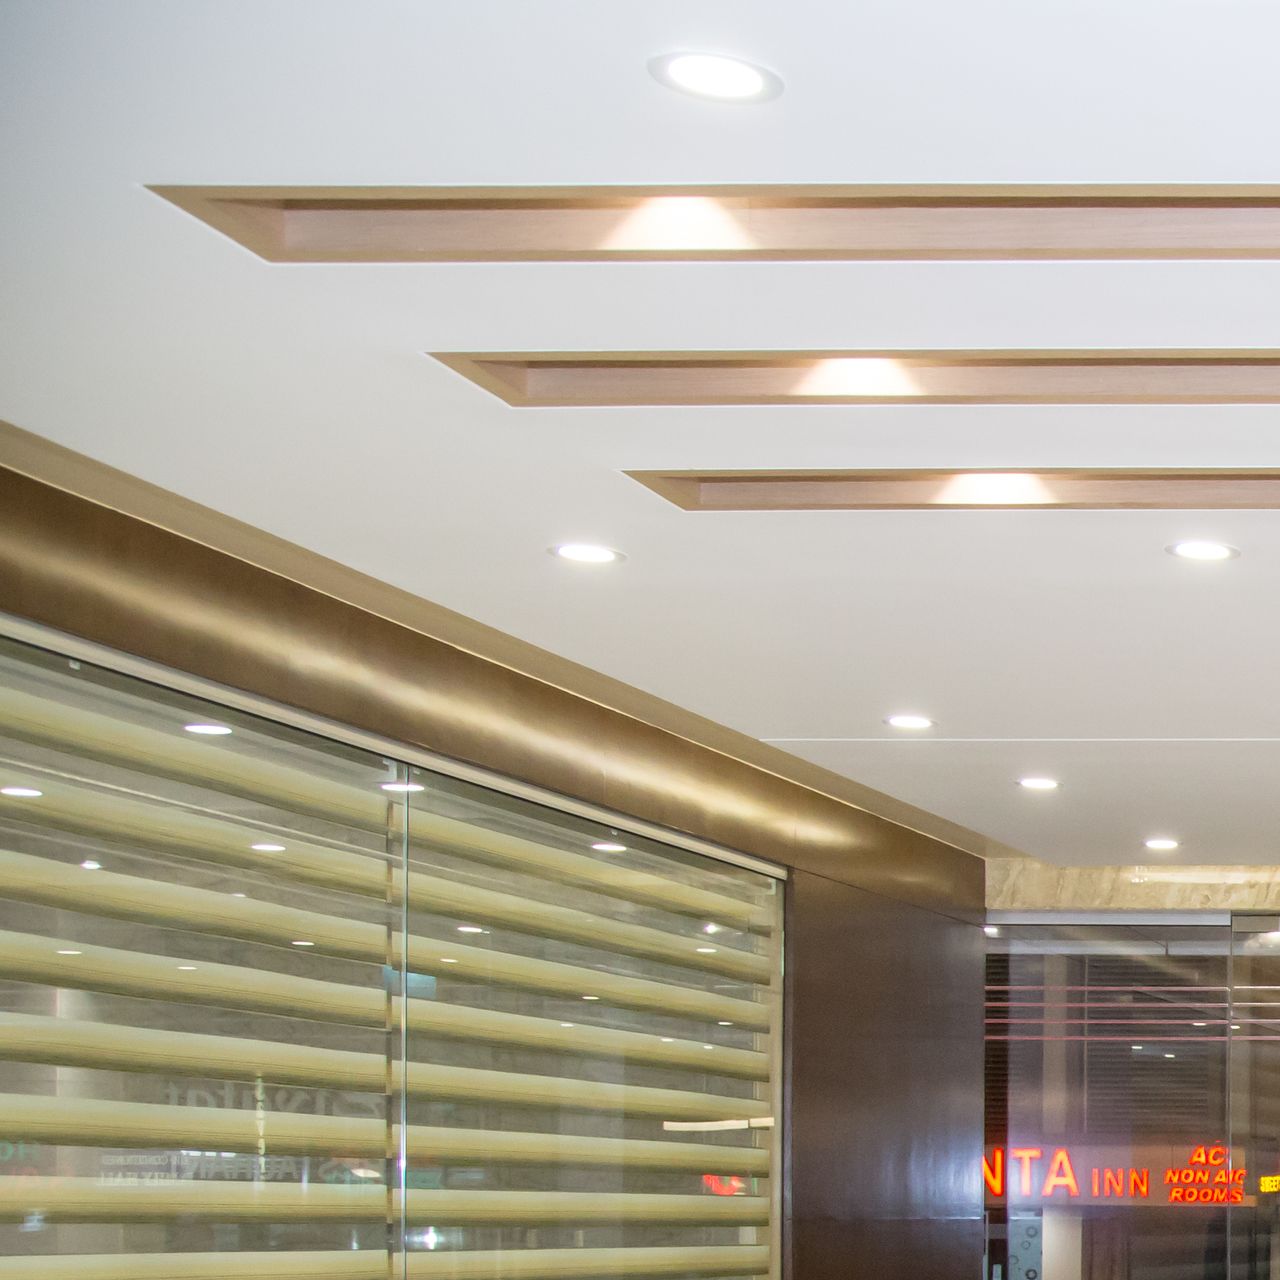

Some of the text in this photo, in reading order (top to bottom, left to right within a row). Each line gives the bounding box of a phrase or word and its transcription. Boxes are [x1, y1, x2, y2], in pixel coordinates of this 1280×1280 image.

[1091, 1167, 1150, 1199] INN
[1163, 1167, 1210, 1185] NON
[1168, 1186, 1244, 1204] ROOMS
